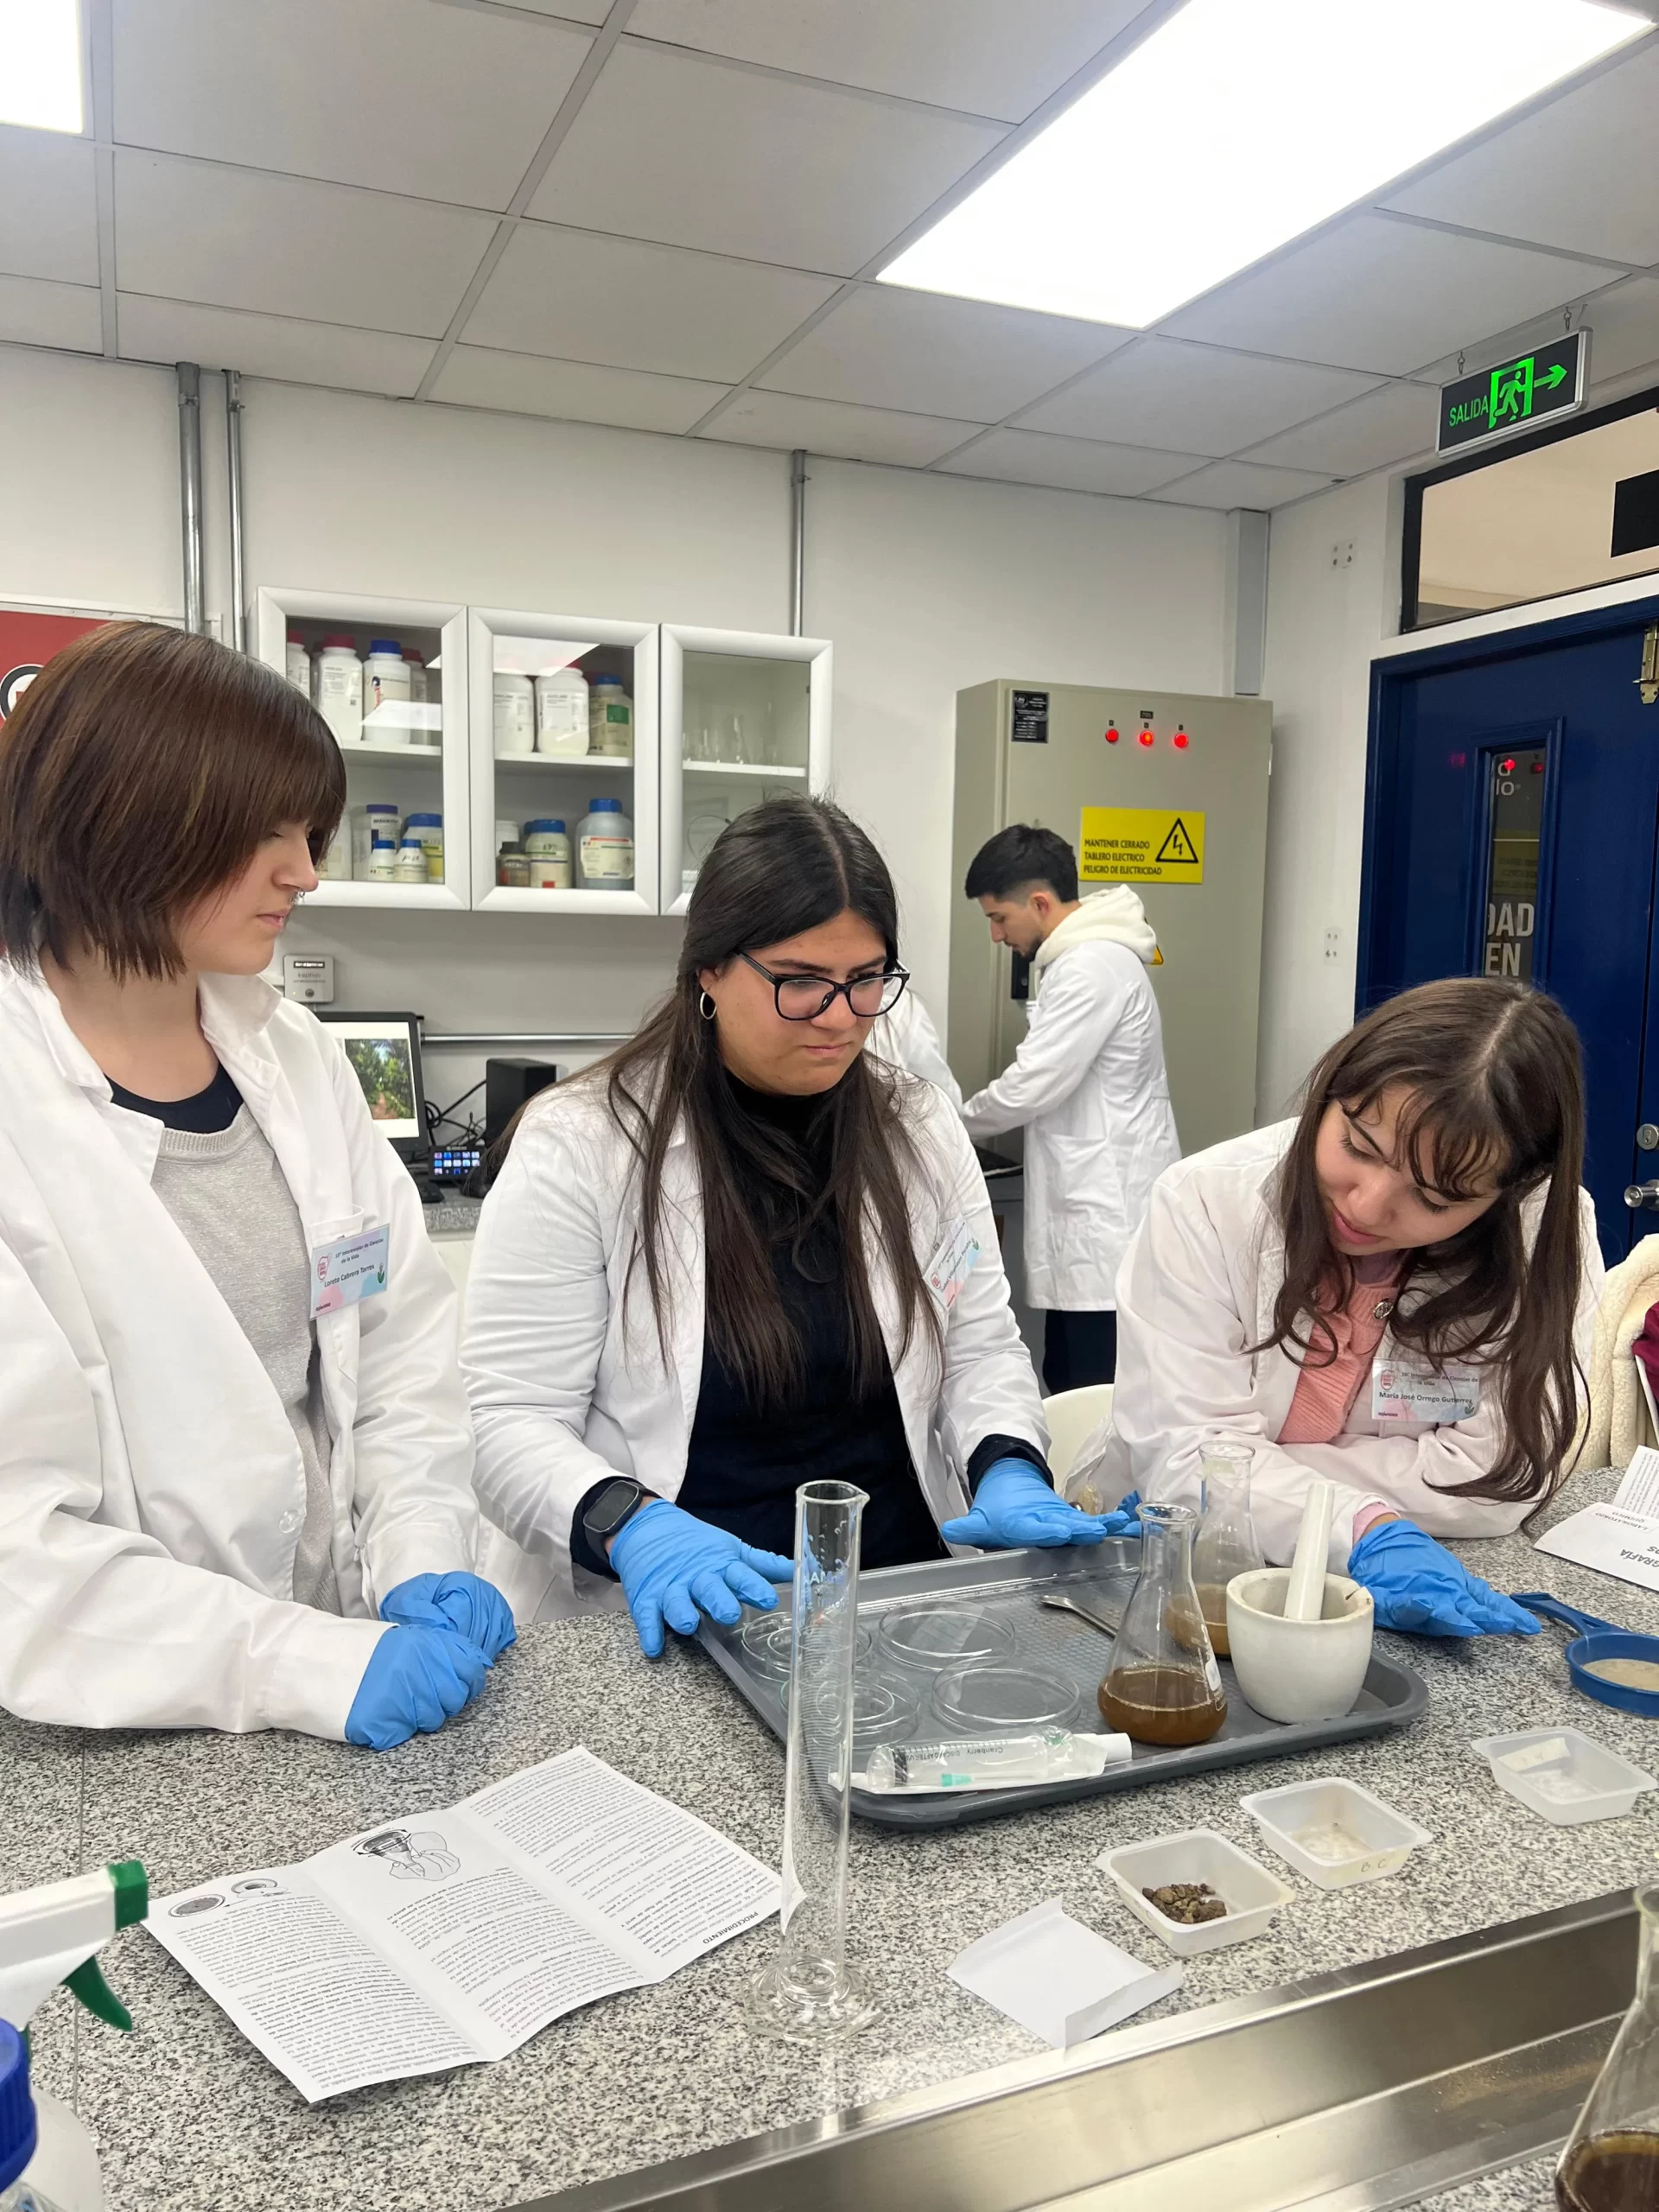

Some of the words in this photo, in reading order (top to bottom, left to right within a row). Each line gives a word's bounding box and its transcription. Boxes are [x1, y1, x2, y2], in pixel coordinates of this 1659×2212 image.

[1448, 395, 1489, 427] SALIDA
[1084, 839, 1120, 848] MANTENER
[1121, 840, 1150, 849] CERRADO
[1084, 852, 1111, 861] TABLERO
[1112, 853, 1145, 862] ELECTRICO
[1084, 865, 1109, 874] PELIGRO
[1120, 866, 1162, 875] ELECTRICIDAD
[324, 1275, 339, 1287] Loreto
[340, 1268, 359, 1281] Cabrera
[360, 1263, 373, 1273] Torres
[1595, 1512, 1648, 1530] LABORATORIO
[966, 1745, 1003, 1756] Cranberry
[702, 1911, 759, 1944] PROCEDIMIENTO
